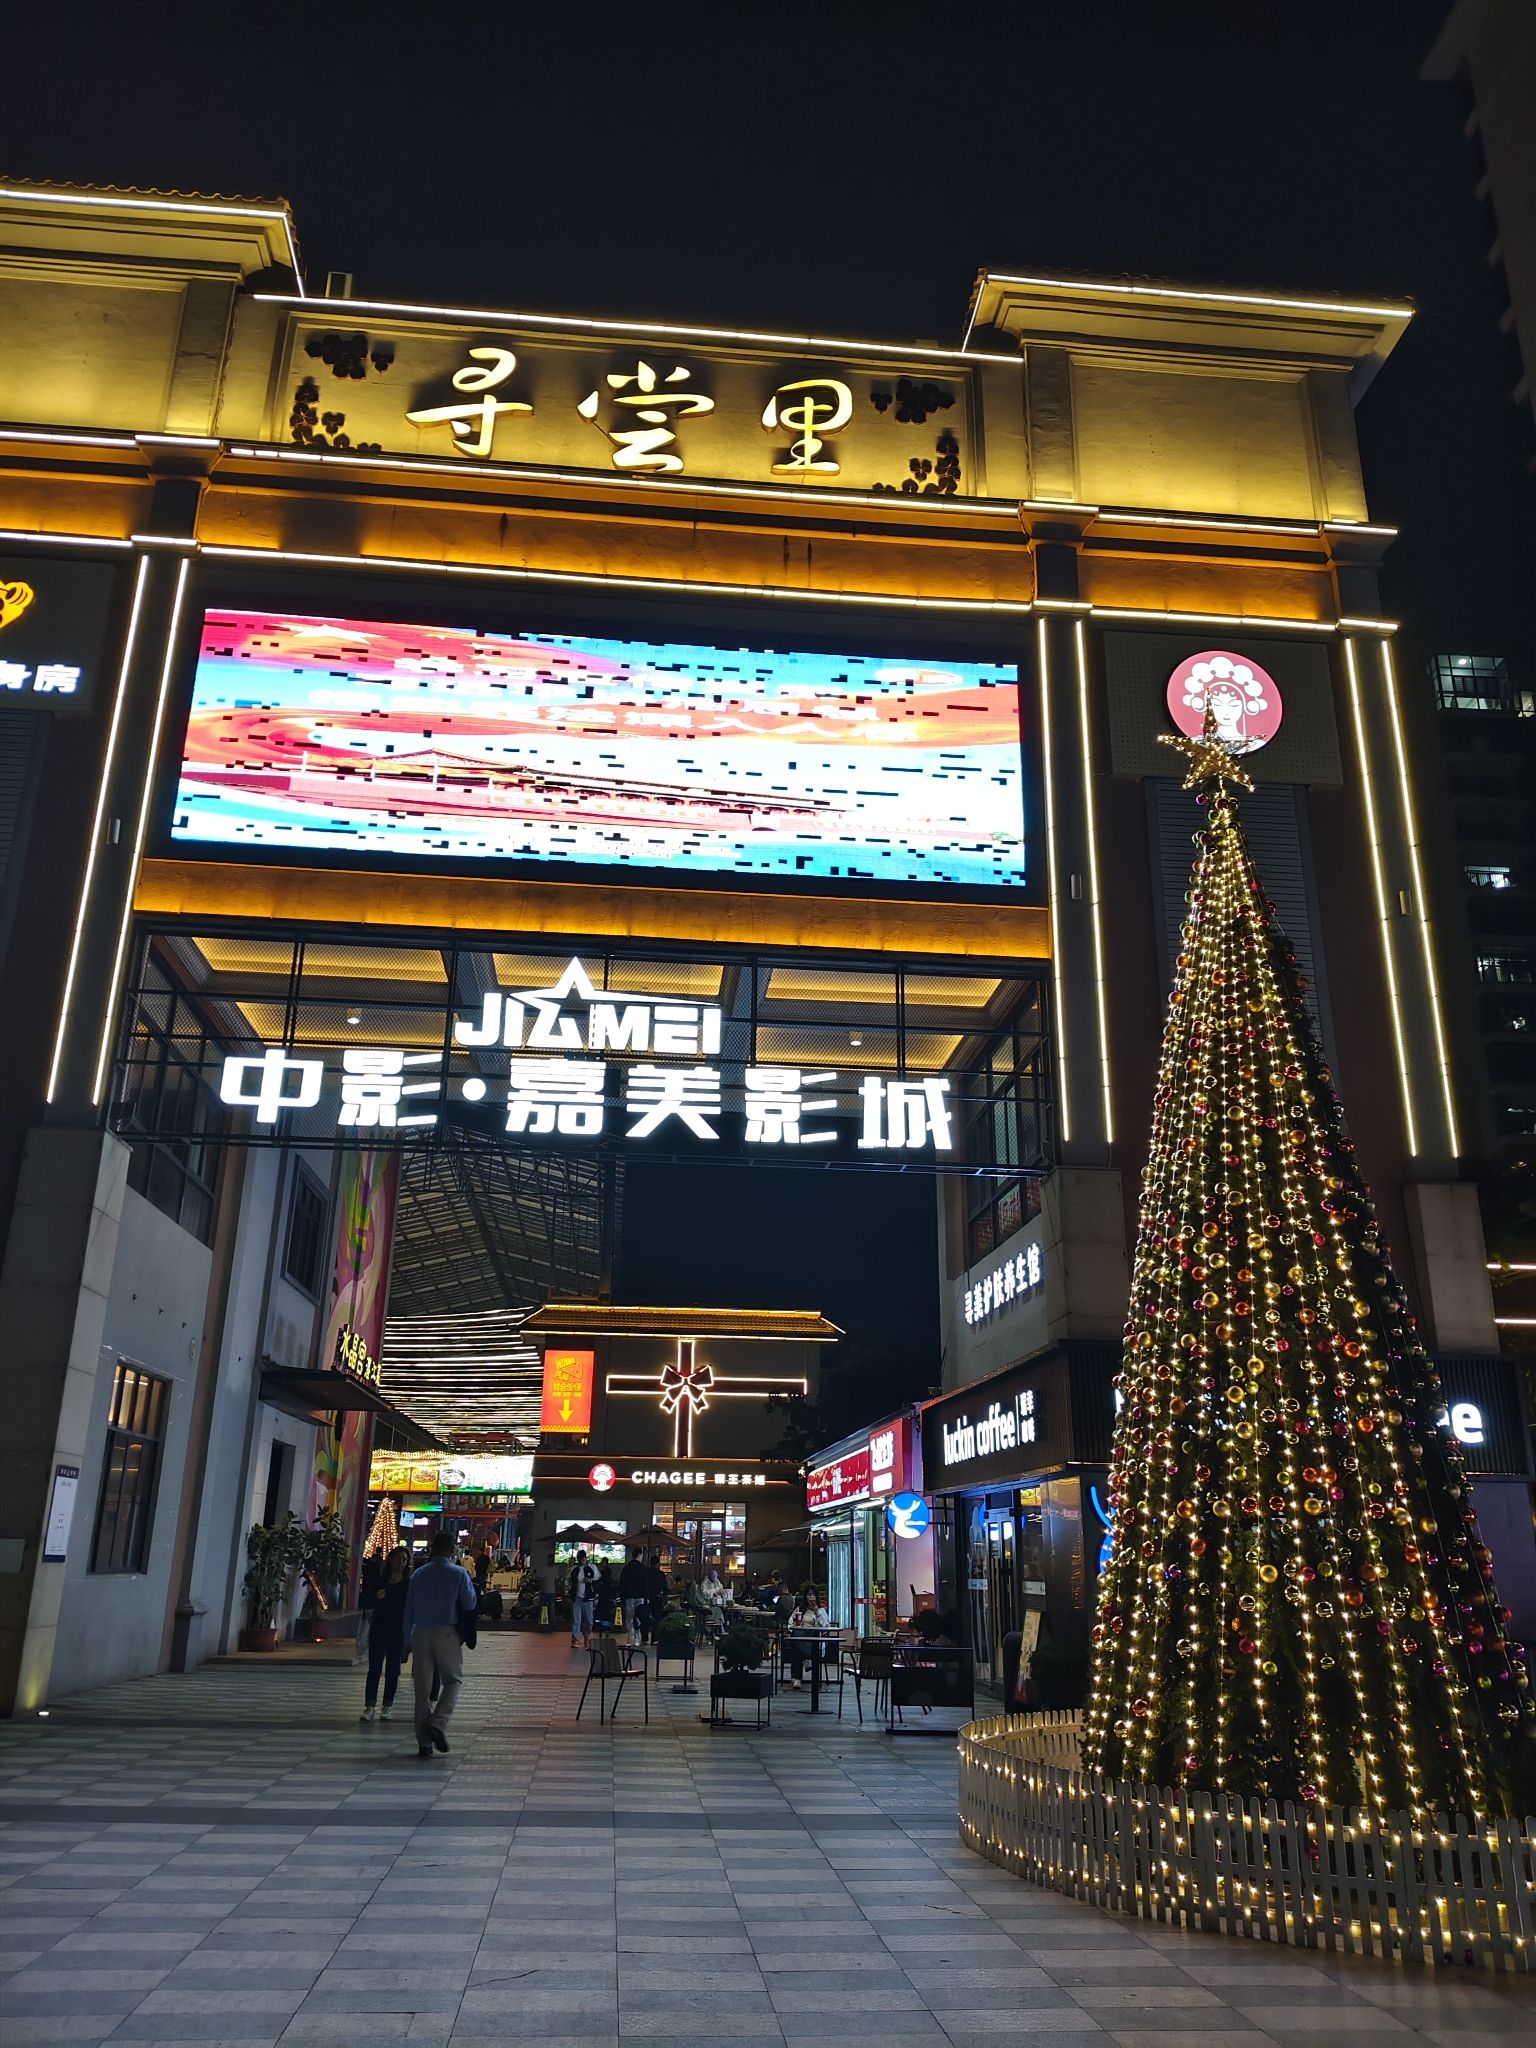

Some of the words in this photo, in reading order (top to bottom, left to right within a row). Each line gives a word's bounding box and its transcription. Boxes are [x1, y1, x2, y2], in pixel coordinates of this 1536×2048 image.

[454, 956, 722, 1055] JIAMEI
[964, 1242, 1040, 1325] 寻美护肤养生馆
[943, 1414, 975, 1466] luckin
[976, 1402, 1016, 1457] coffee
[631, 1471, 706, 1486] CHAGEE
